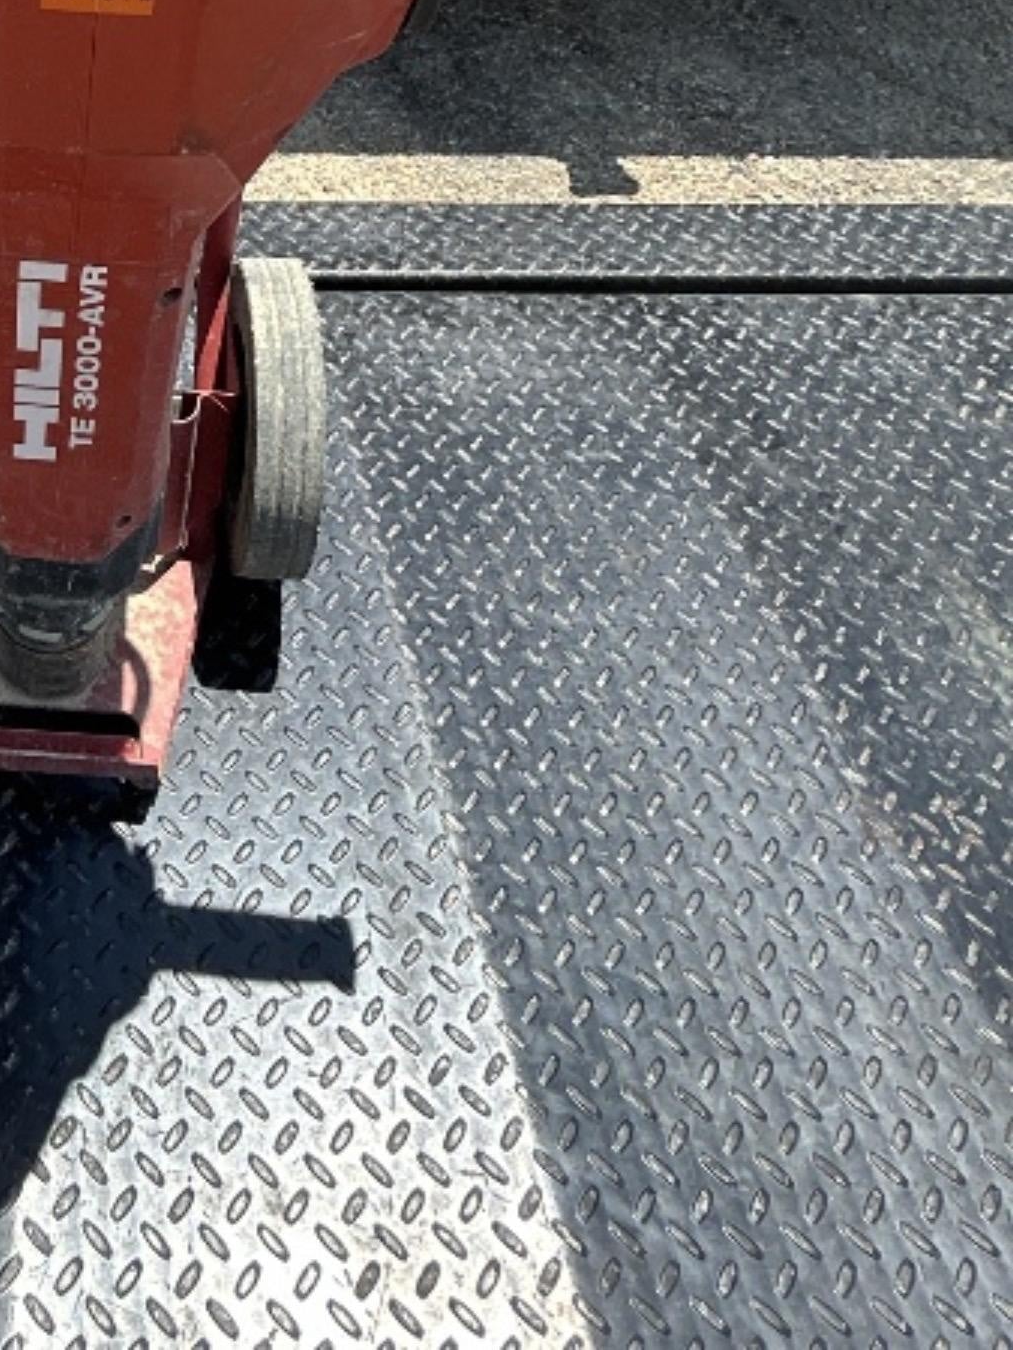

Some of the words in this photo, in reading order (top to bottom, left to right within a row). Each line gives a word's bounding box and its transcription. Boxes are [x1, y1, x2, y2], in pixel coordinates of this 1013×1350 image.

[13, 260, 69, 462] HILTI
[72, 264, 109, 411] 3000-AVR
[68, 416, 96, 450] TE
